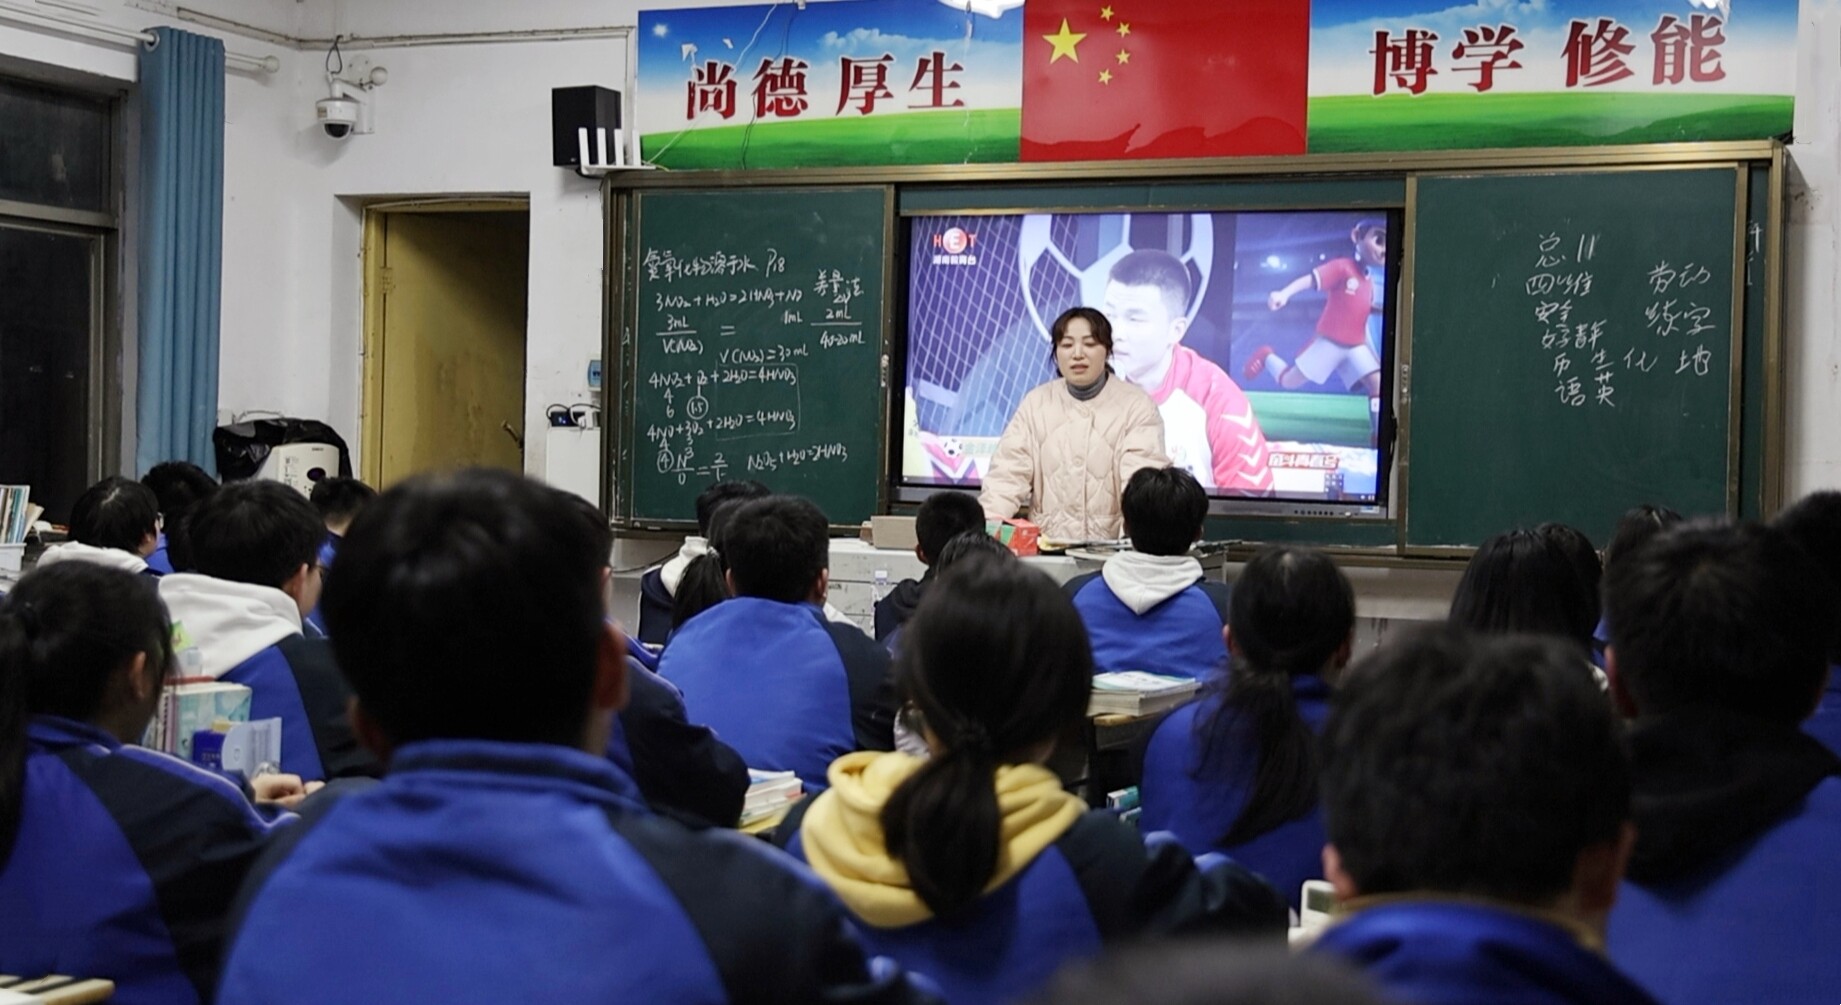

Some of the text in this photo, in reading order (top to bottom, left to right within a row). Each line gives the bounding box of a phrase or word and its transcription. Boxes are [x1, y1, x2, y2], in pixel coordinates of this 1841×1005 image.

[686, 51, 966, 120] 尚德 厚生
[1368, 14, 1728, 96] 博学 修能
[1646, 260, 1711, 296] 劳动
